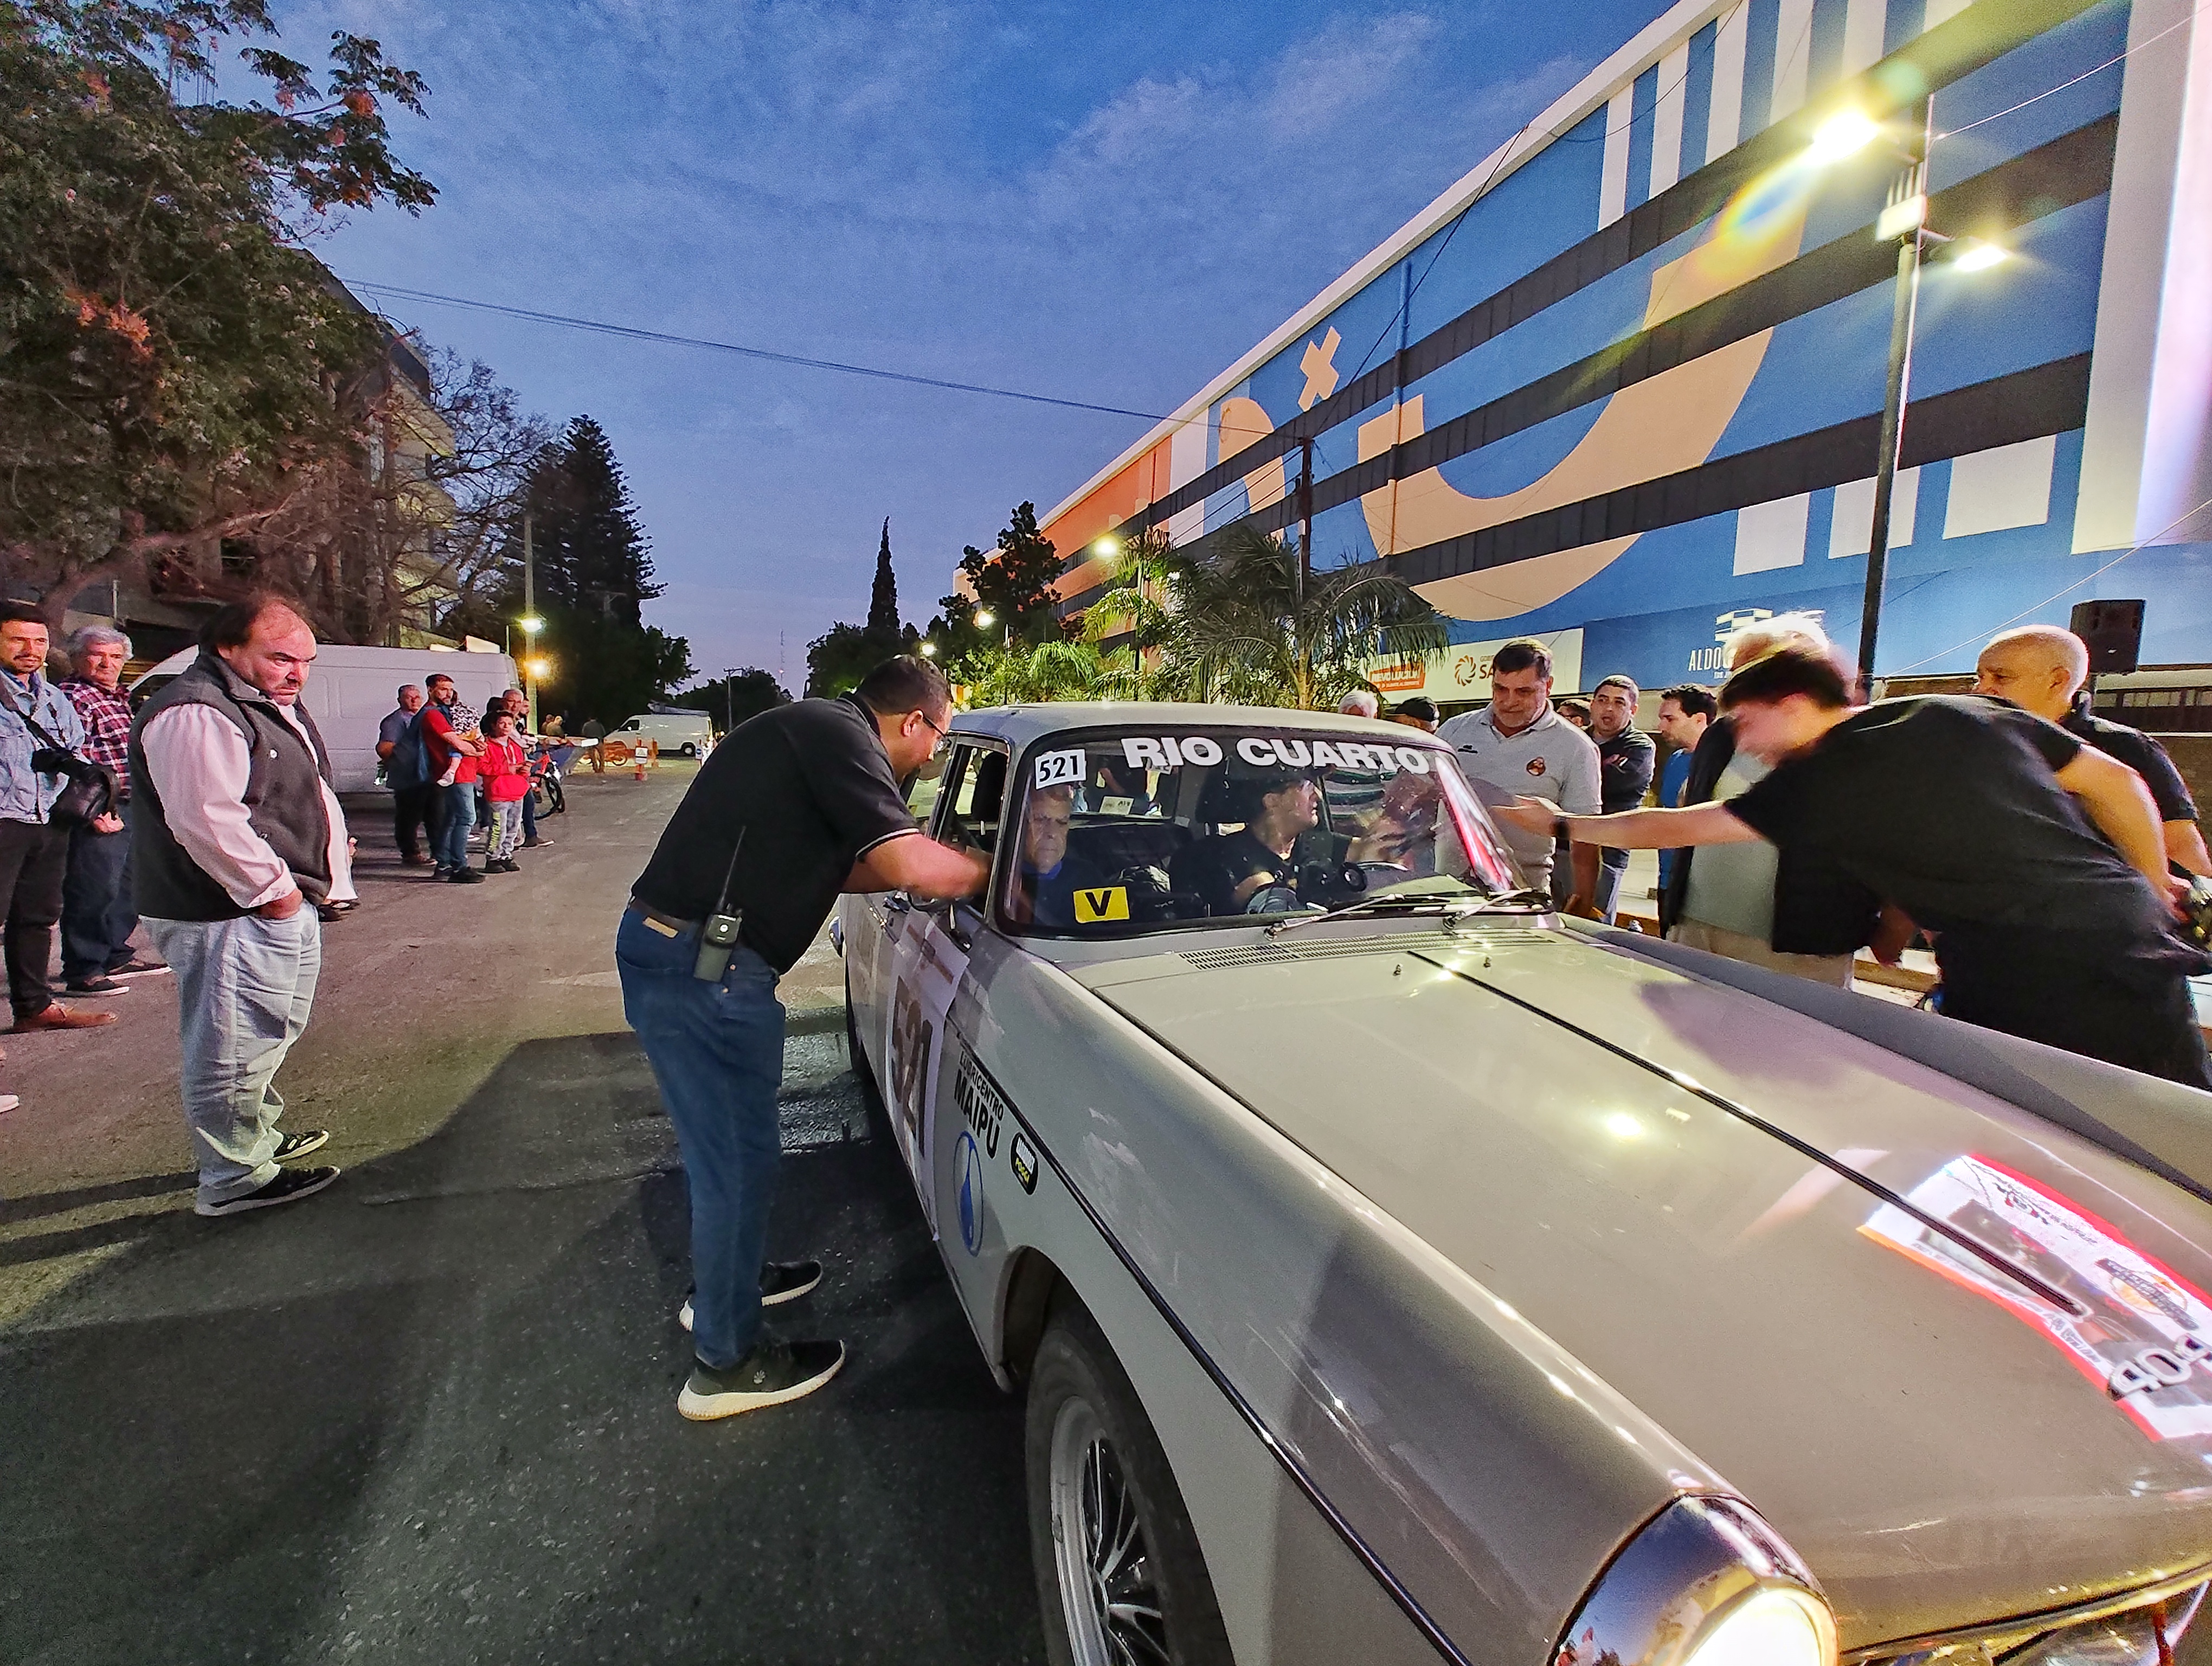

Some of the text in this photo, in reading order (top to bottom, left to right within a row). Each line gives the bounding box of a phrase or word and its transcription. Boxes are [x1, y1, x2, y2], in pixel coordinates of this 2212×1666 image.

[1039, 755, 1078, 783] 521
[1121, 737, 1430, 774] RIO CUARTO
[1085, 890, 1111, 917] V
[891, 975, 933, 1160] 521
[960, 1050, 1004, 1122] LUBRICENTRO
